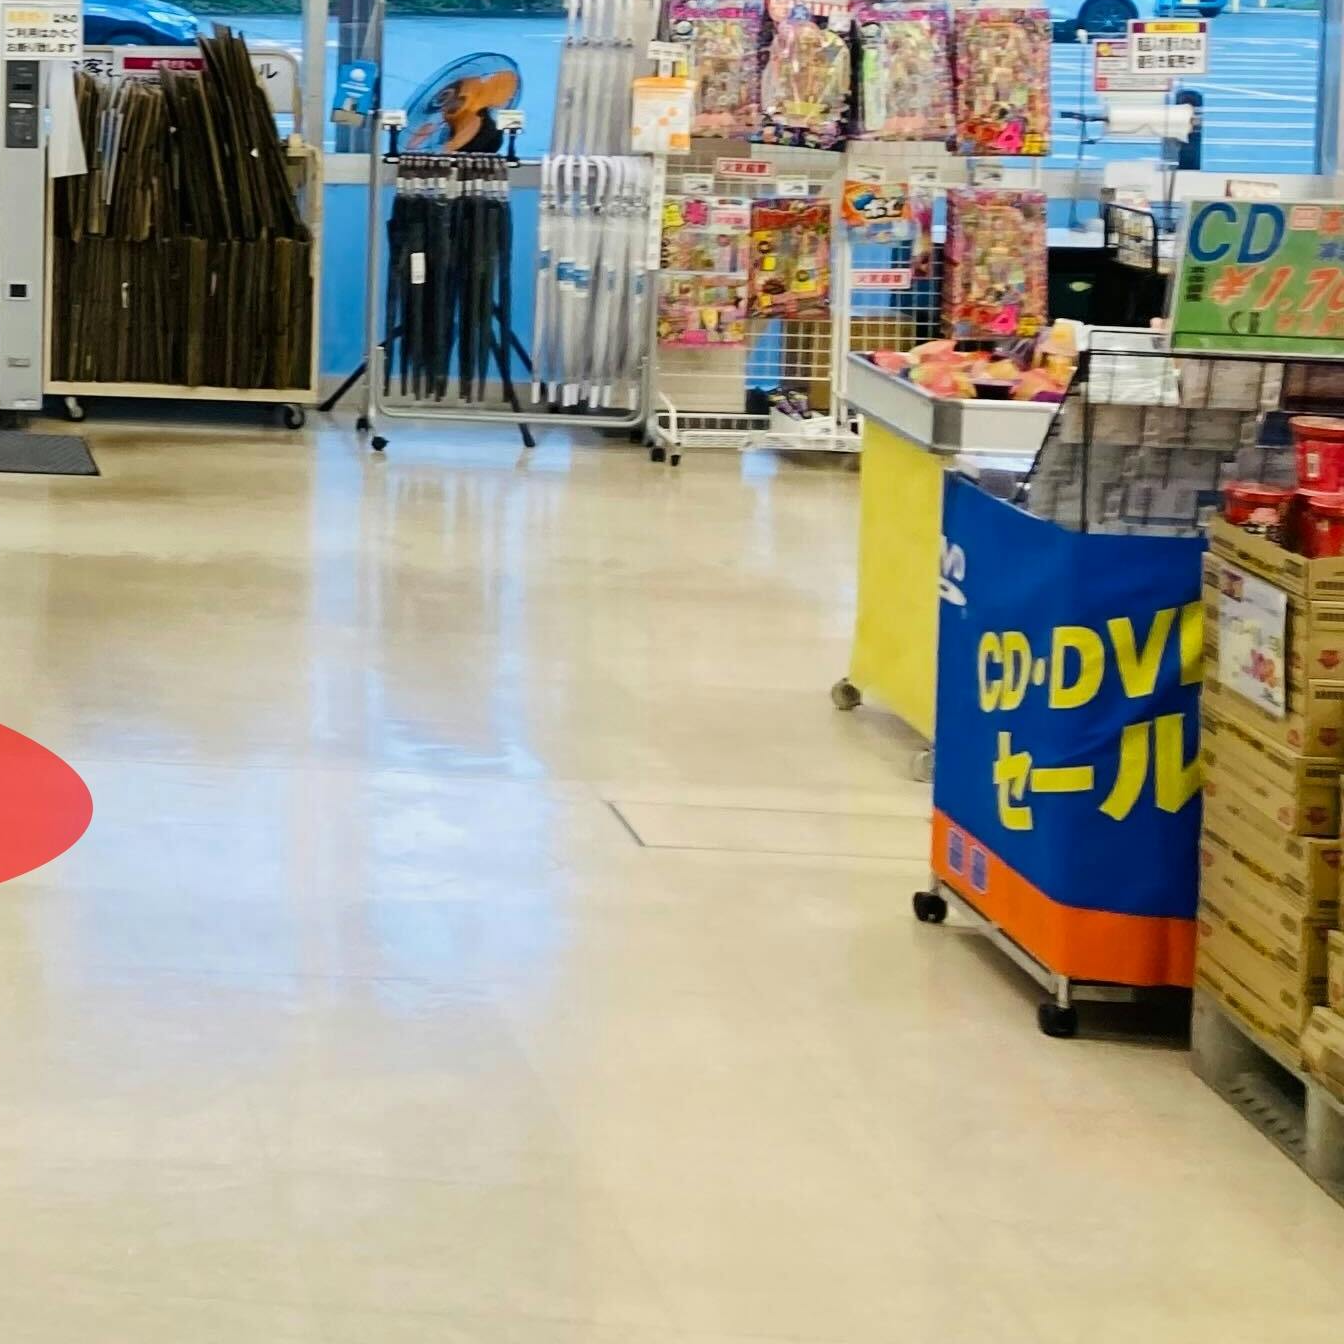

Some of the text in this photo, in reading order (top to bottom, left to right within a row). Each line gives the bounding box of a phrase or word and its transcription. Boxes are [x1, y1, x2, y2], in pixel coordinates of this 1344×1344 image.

[1189, 201, 1286, 264] CD
[993, 712, 1201, 830] セール
